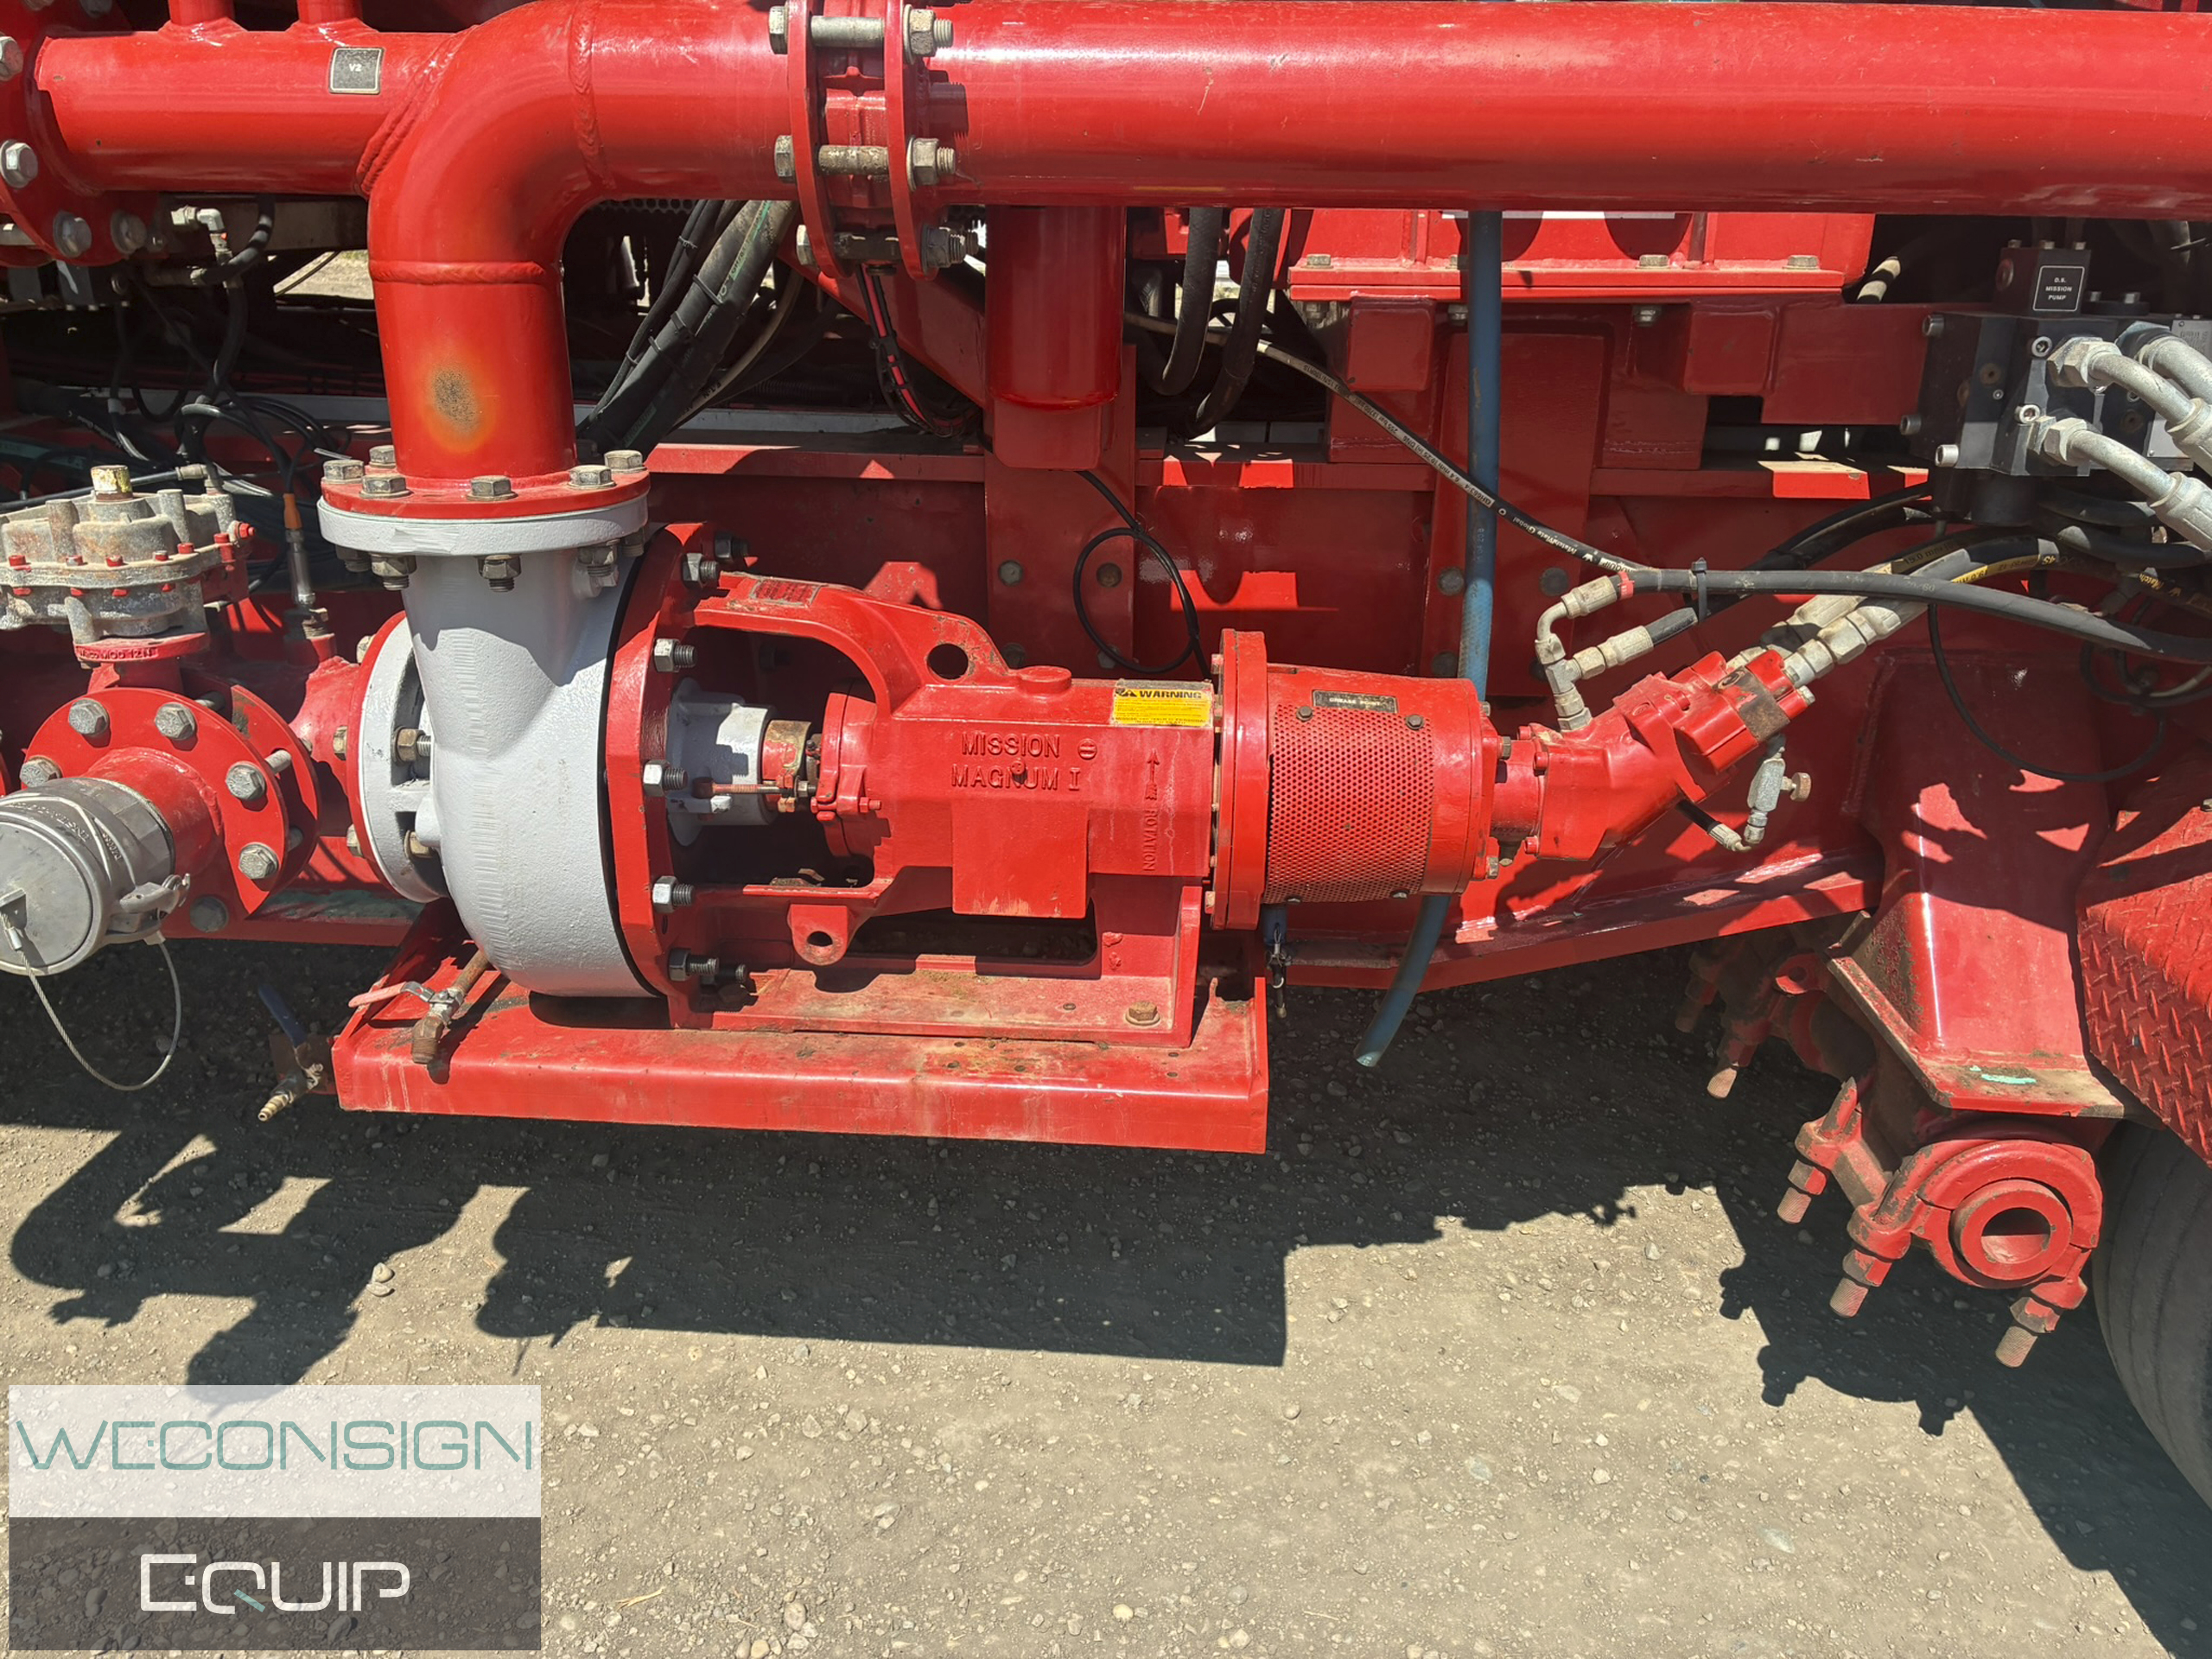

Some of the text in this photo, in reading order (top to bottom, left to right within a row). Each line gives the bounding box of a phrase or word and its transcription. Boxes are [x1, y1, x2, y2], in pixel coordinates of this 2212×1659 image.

[348, 63, 362, 72] V2
[1510, 515, 1538, 535] Global
[1140, 690, 1202, 699] WARNING
[961, 732, 1060, 758] MISSION
[951, 764, 1080, 791] MAGNUM I
[1142, 809, 1158, 871] ROTATION
